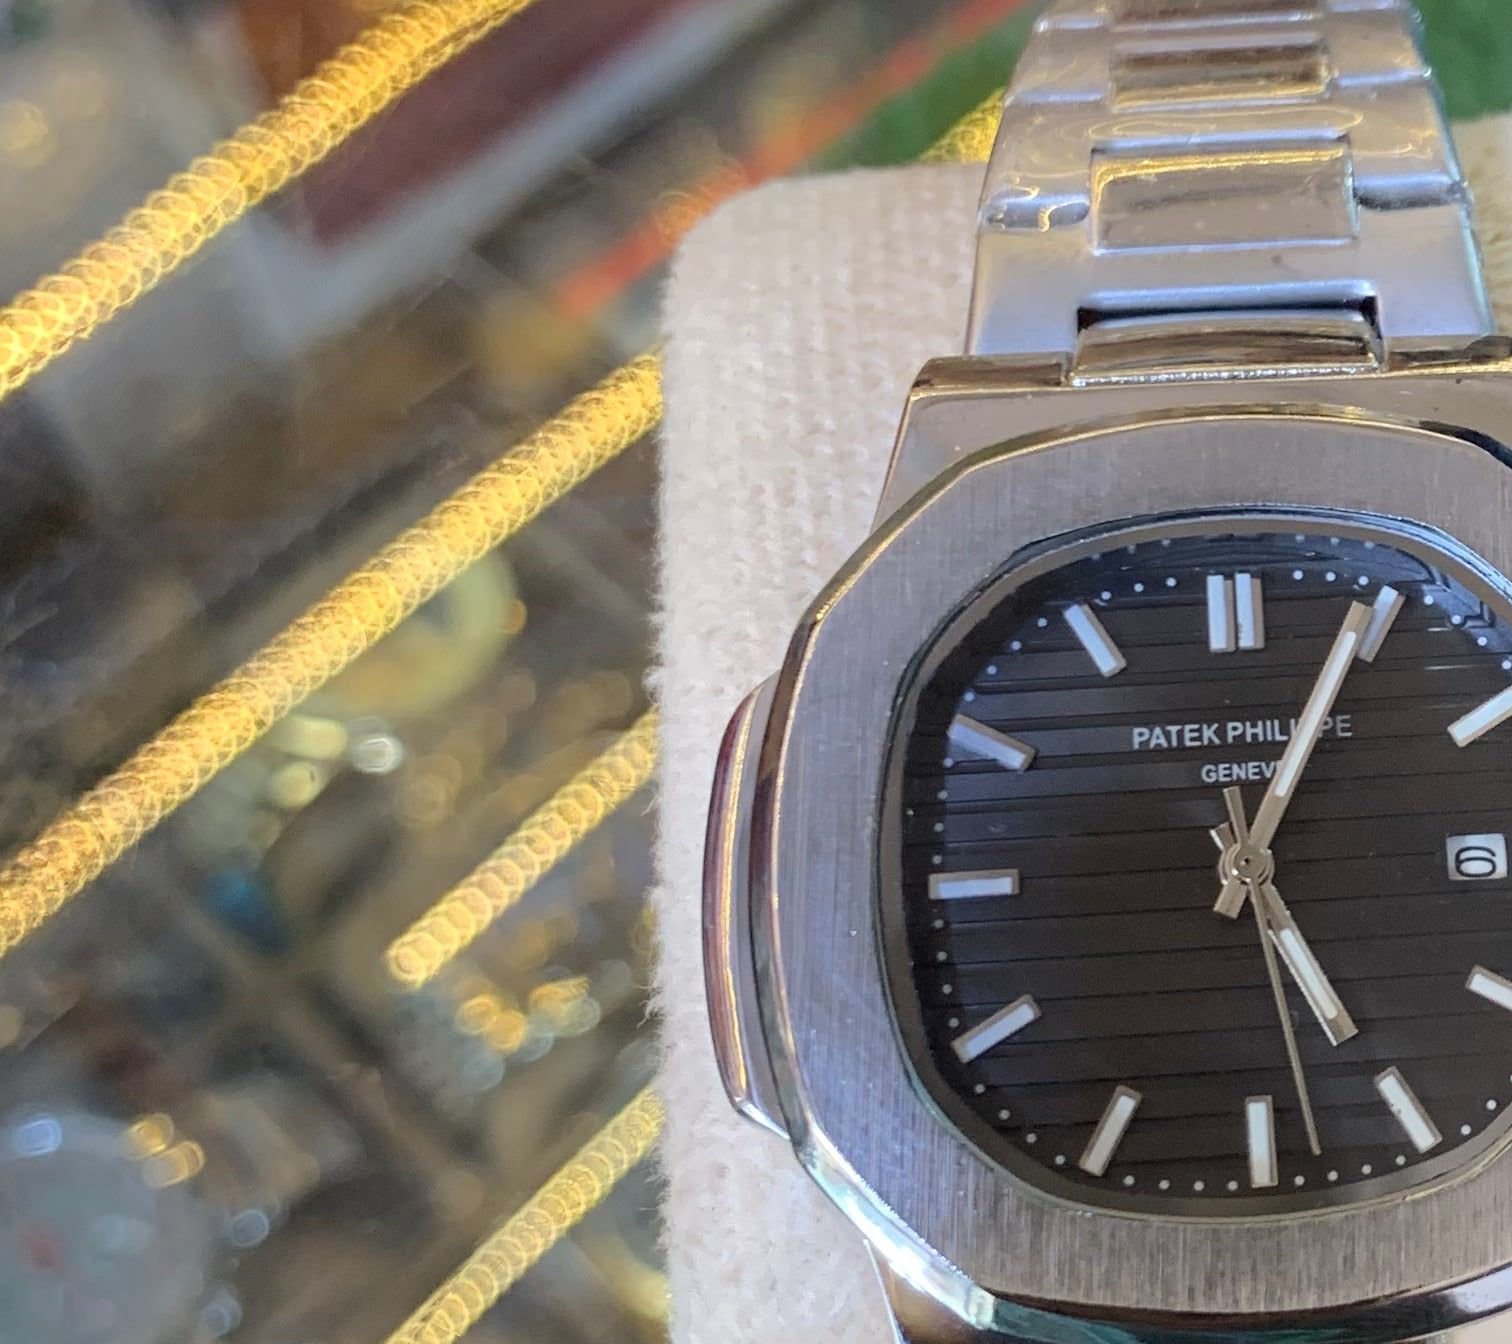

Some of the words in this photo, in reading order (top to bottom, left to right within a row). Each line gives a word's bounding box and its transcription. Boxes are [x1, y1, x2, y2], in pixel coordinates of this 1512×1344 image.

[1132, 722, 1220, 750] PATEK
[1226, 714, 1353, 744] PHILIPE
[1200, 760, 1283, 784] GENEV
[1454, 845, 1497, 878] 6
